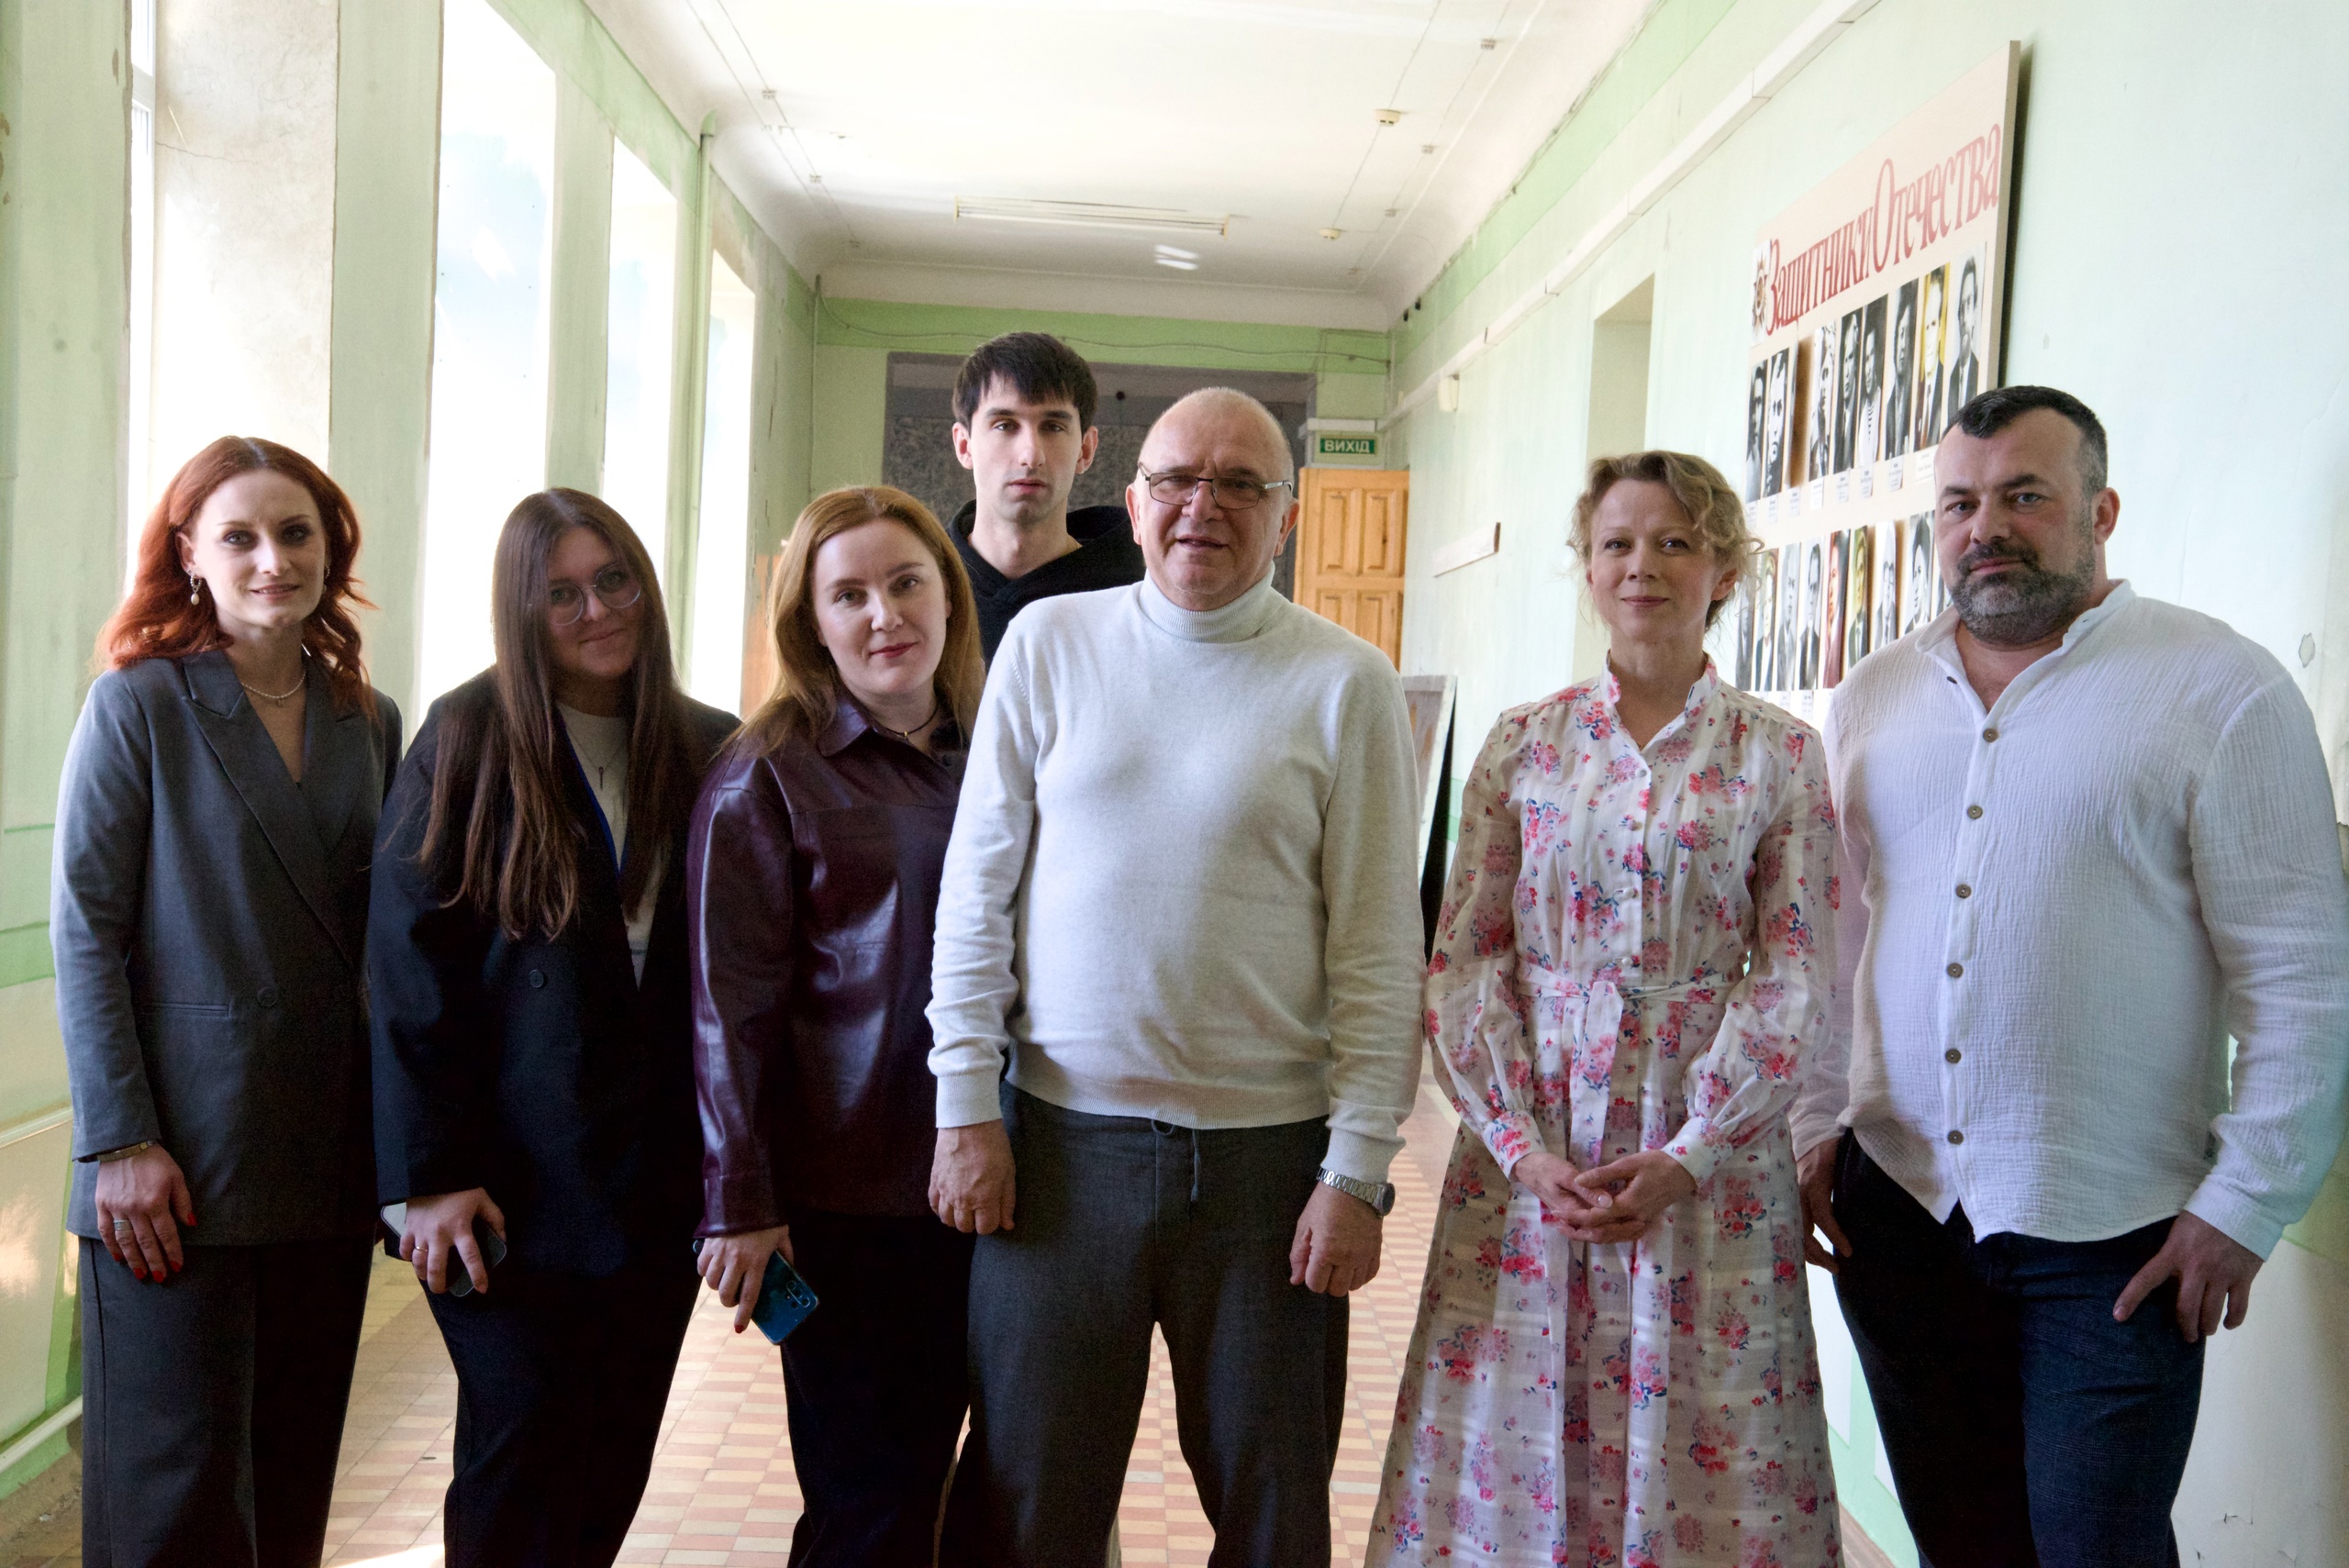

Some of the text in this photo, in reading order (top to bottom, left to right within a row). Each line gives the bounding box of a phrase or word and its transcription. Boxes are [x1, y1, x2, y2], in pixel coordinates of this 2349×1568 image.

[1765, 123, 2001, 336] Защитники Отечества
[1324, 439, 1370, 453] ВИХІД
